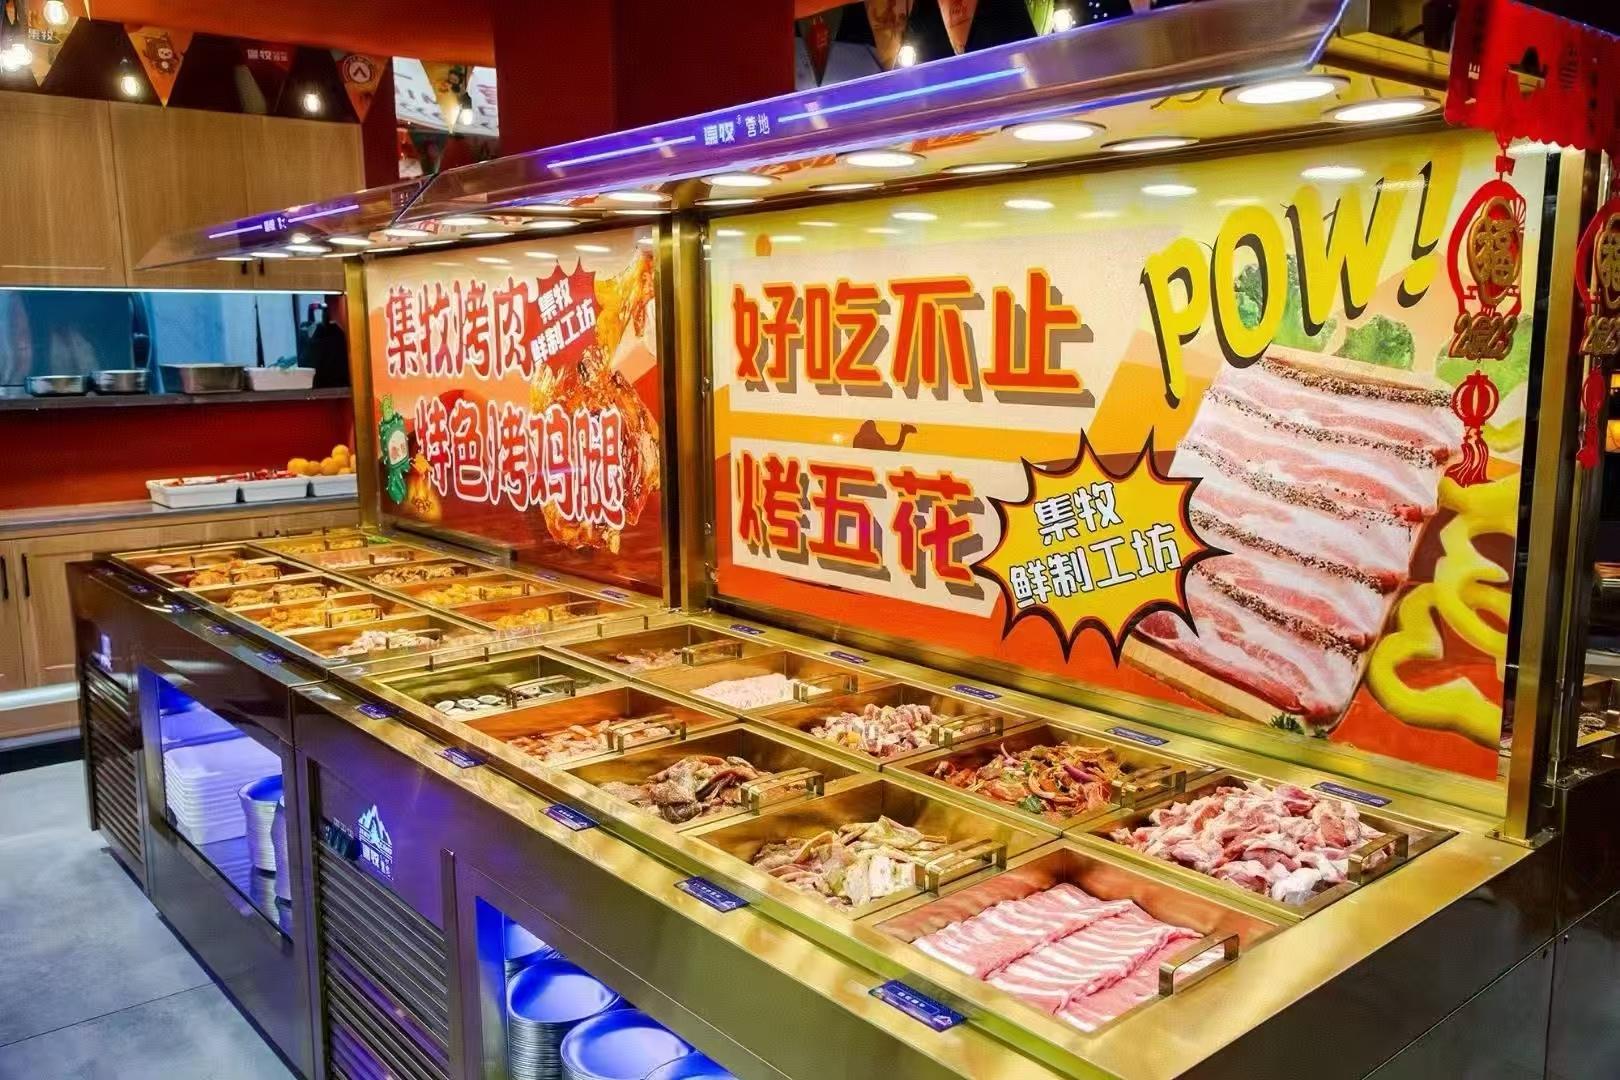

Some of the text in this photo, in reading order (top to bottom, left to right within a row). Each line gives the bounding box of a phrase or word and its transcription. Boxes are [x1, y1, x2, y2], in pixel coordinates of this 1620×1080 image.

[538, 277, 573, 325] 集牧
[1139, 140, 1462, 409] POW!
[385, 276, 535, 381] 集牧烤肉
[530, 298, 597, 366] 鲜制工坊
[732, 267, 1085, 397] 好吃不止
[414, 397, 626, 529] 特色烤鸡腿
[1034, 481, 1124, 546] 集牧
[734, 450, 977, 587] 烤五花
[1009, 523, 1182, 609] 鲜制工坊
